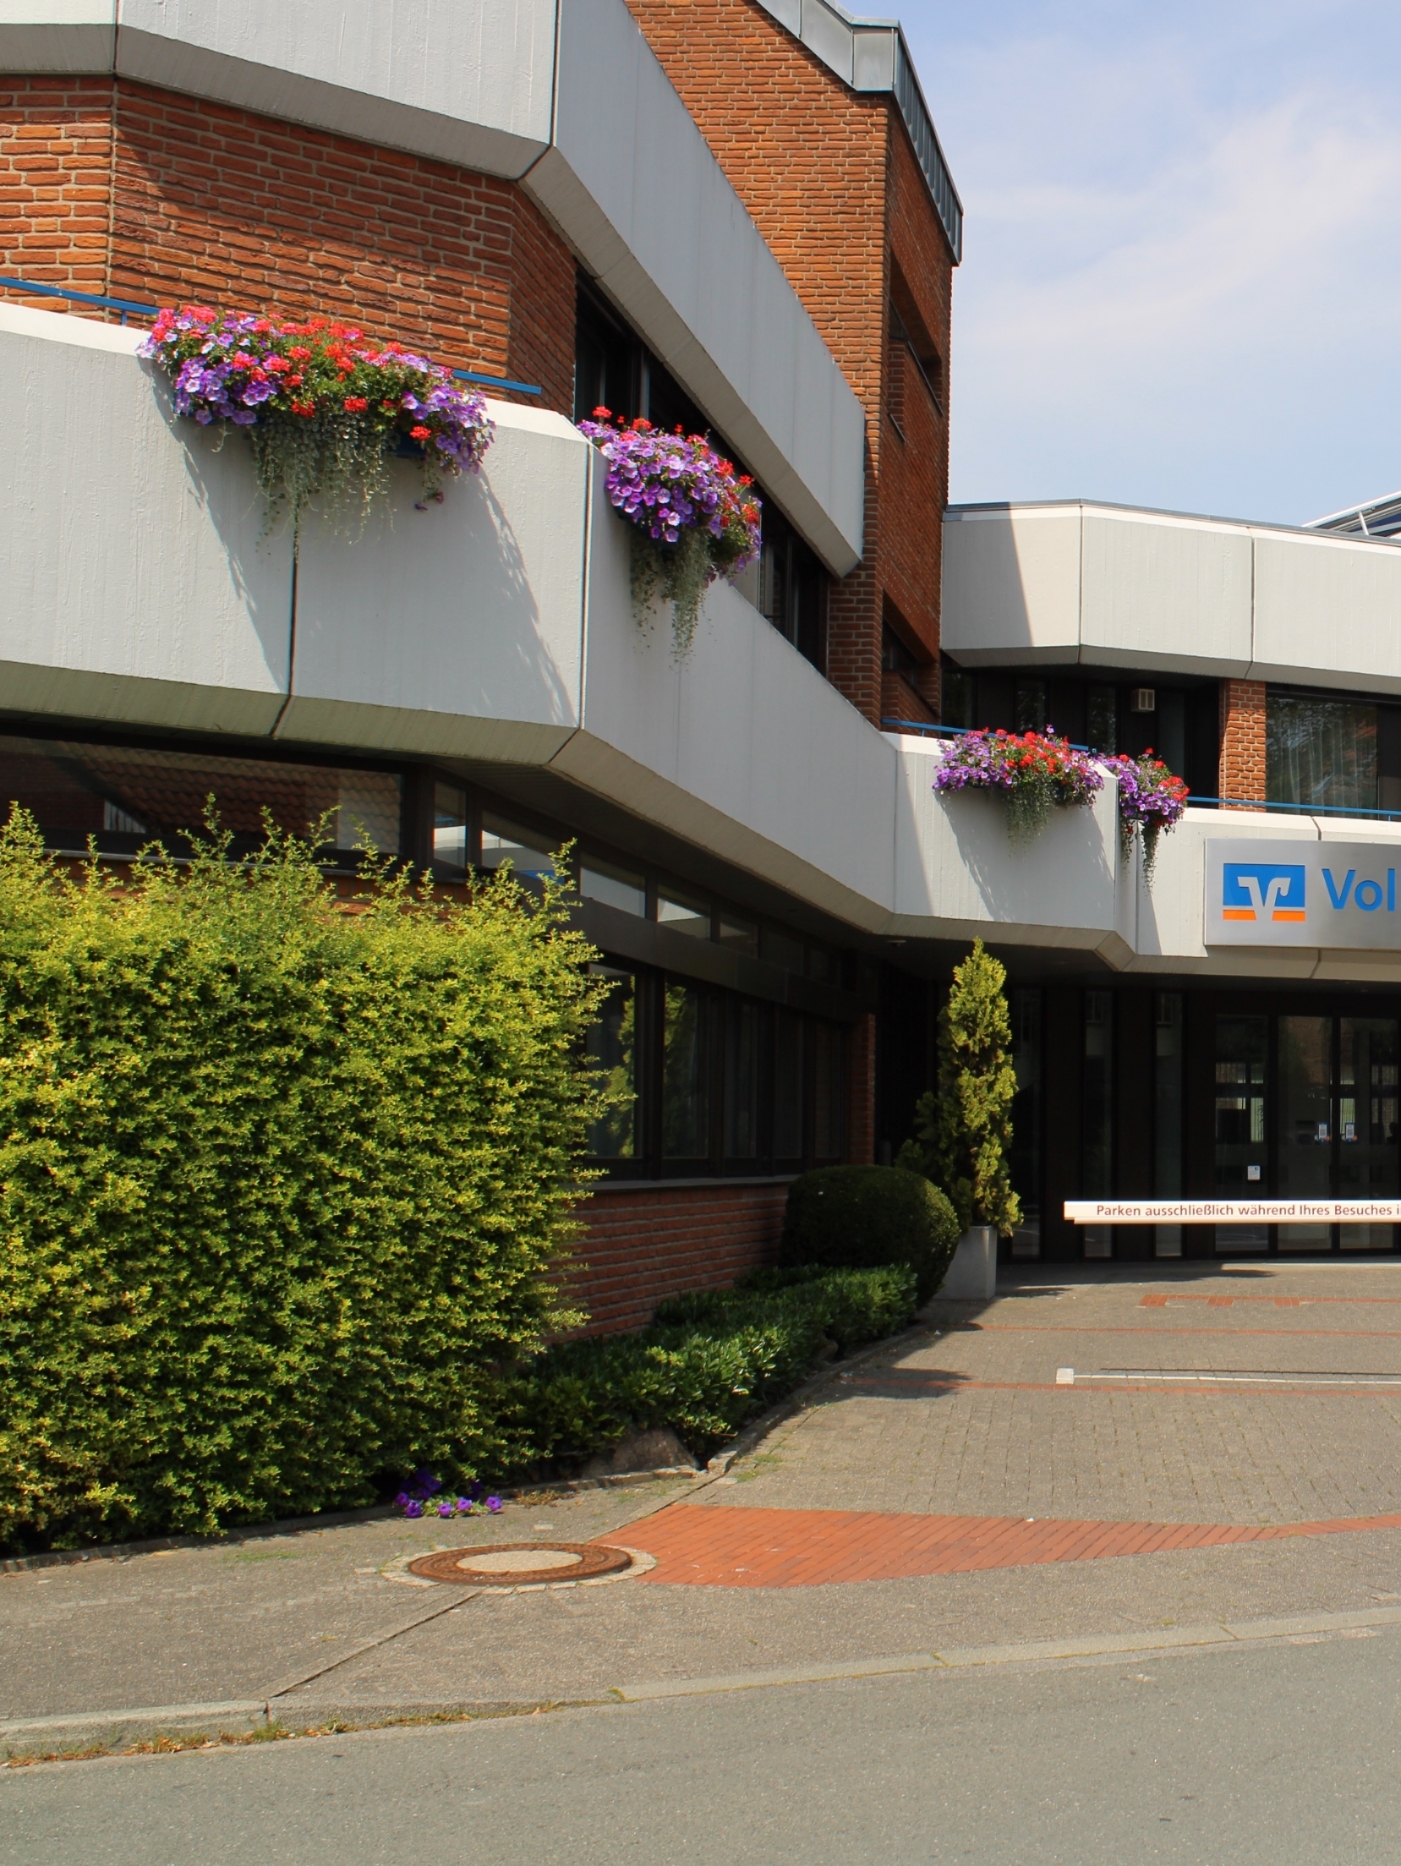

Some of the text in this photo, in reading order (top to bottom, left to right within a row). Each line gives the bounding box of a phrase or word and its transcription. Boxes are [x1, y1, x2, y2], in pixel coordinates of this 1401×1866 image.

[1096, 1204, 1141, 1216] Parken
[1145, 1204, 1234, 1217] ausschließlich
[1238, 1204, 1296, 1216] während
[1299, 1204, 1330, 1216] Ihres
[1334, 1204, 1393, 1216] Besuches
